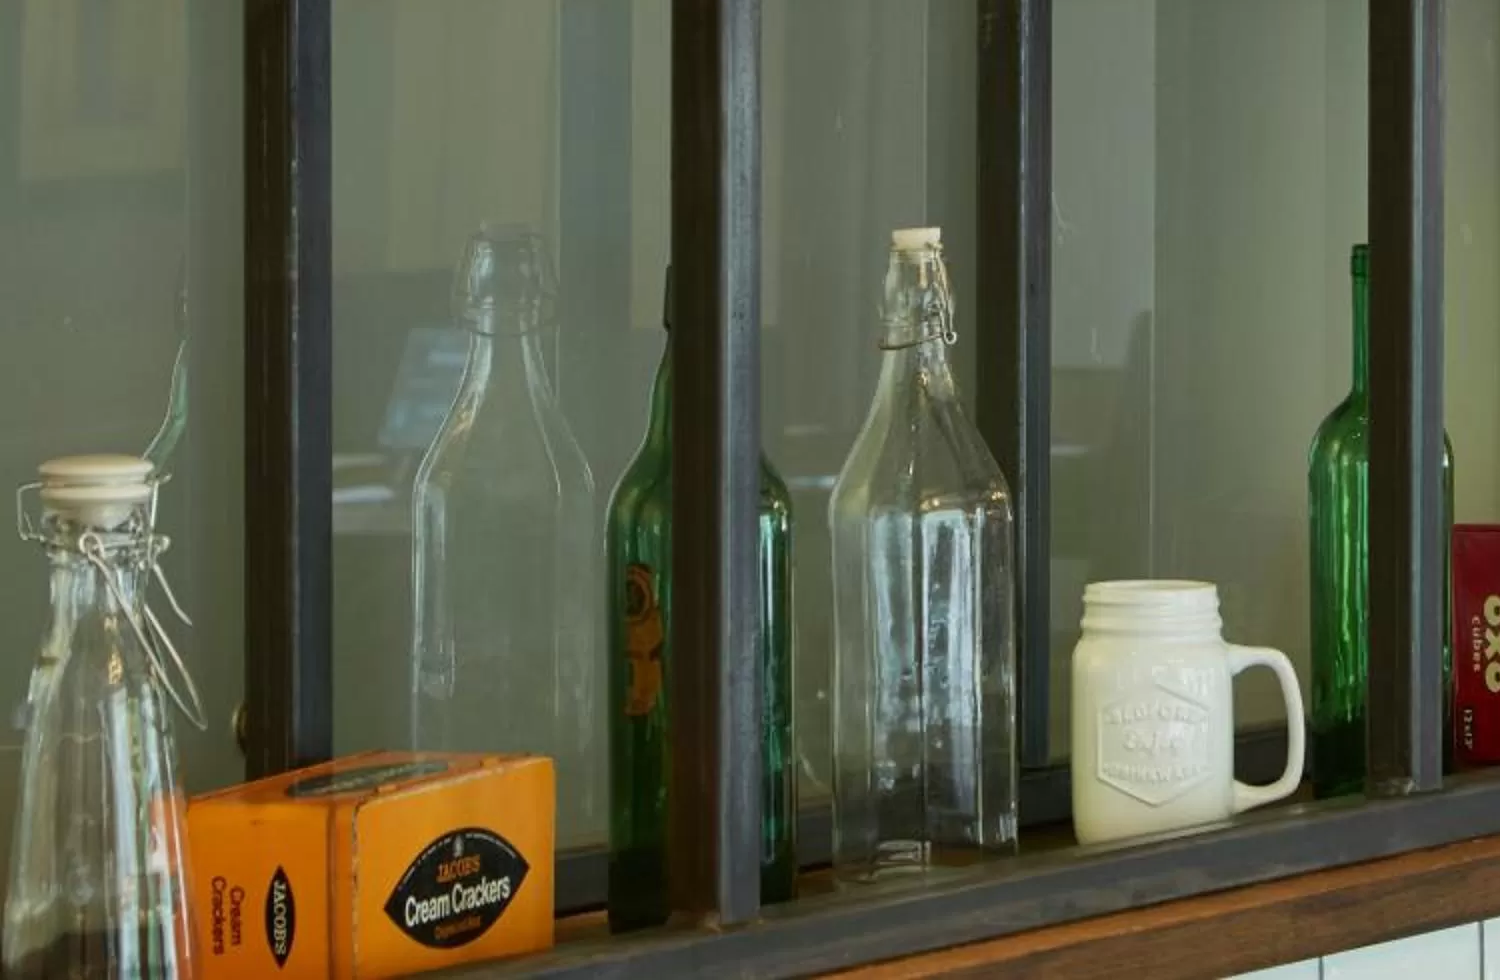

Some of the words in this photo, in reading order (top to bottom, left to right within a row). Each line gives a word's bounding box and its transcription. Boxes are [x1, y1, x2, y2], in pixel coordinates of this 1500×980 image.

[211, 875, 228, 956] Crackers
[230, 885, 245, 946] Cream
[404, 894, 451, 928] Cream
[451, 875, 511, 914] Crackers
